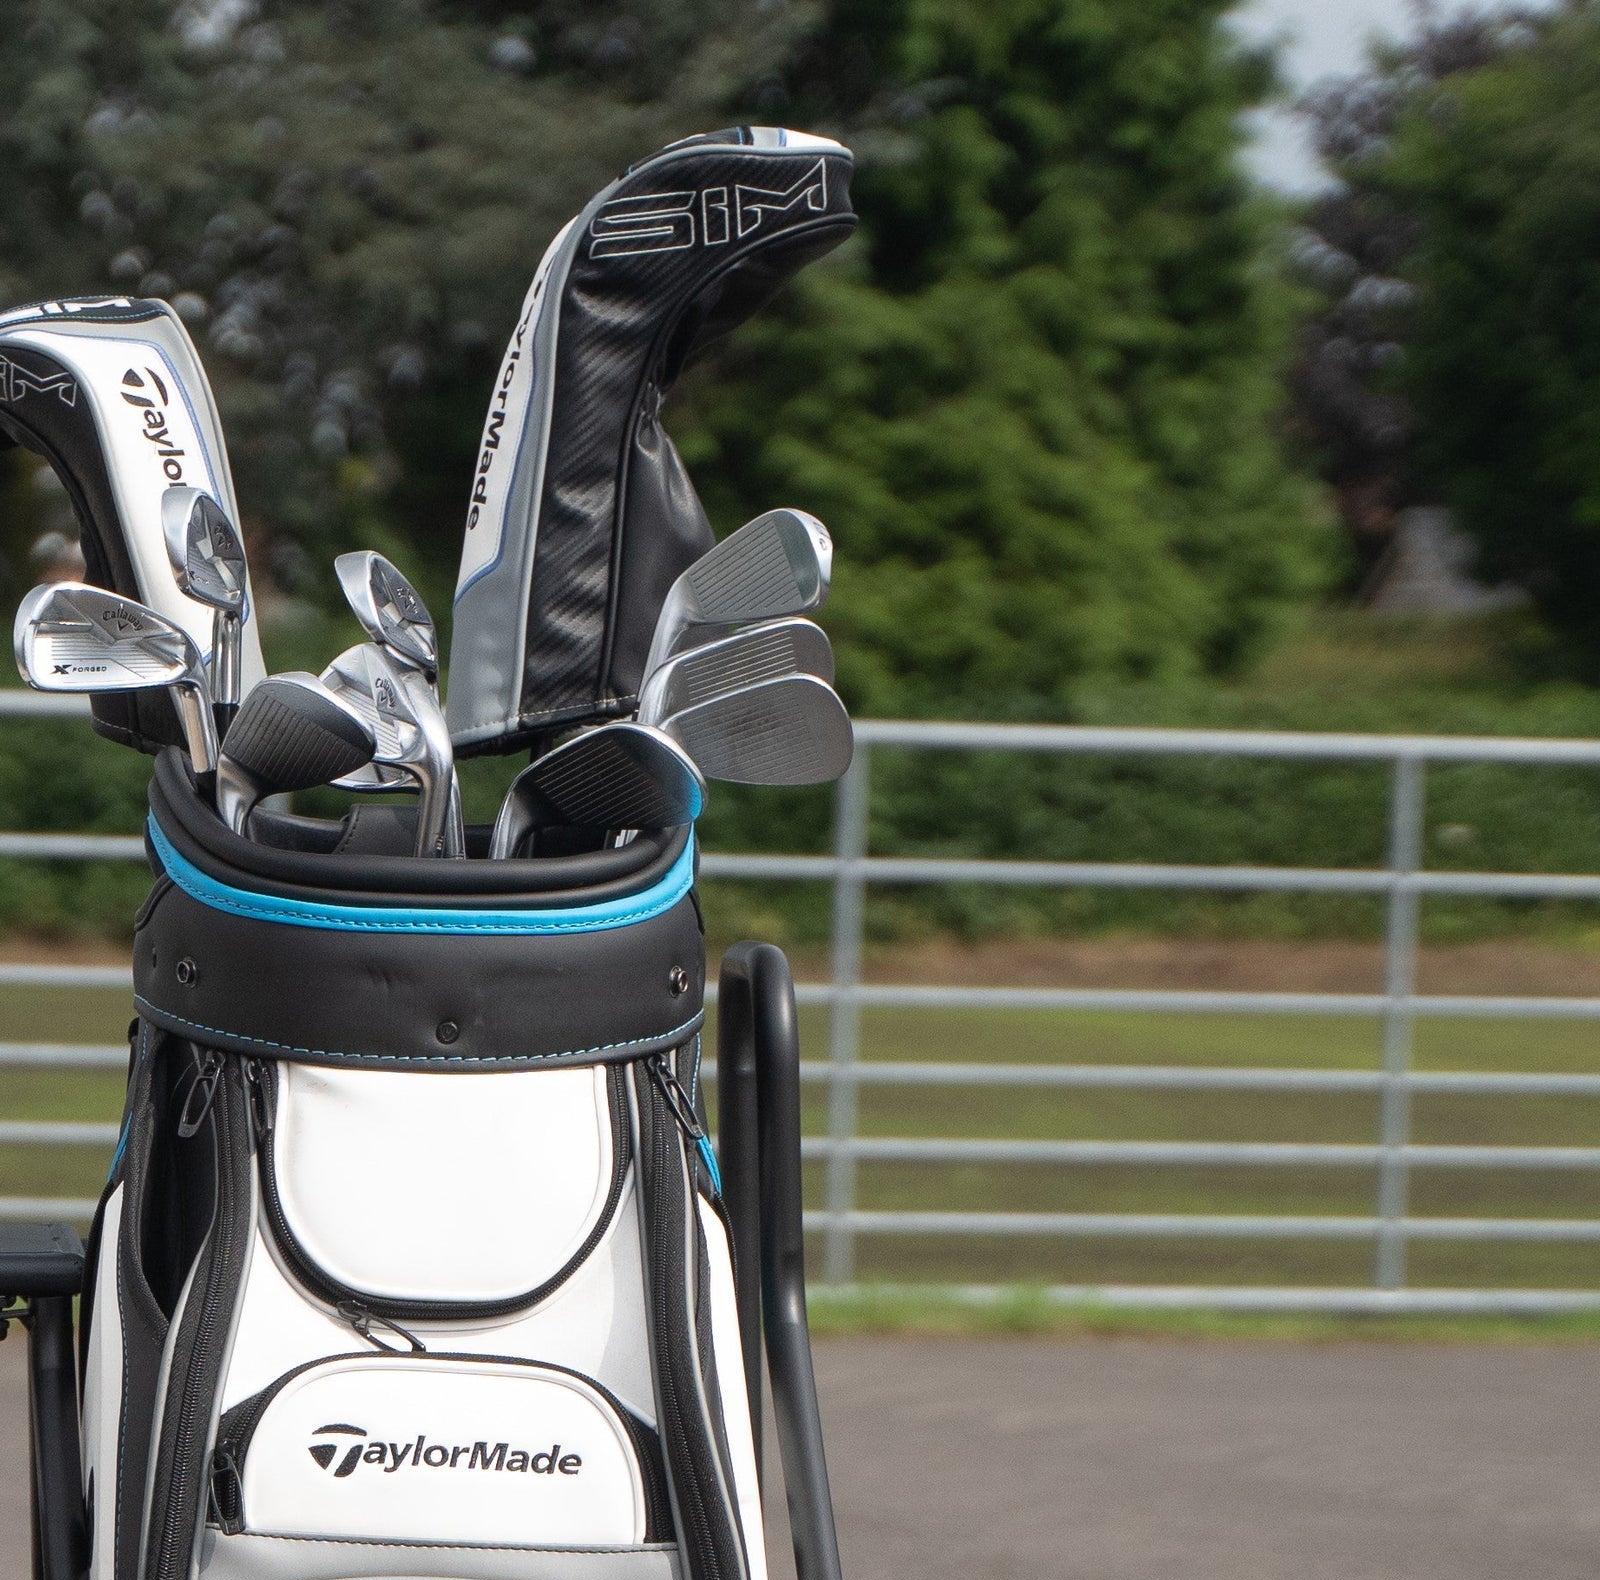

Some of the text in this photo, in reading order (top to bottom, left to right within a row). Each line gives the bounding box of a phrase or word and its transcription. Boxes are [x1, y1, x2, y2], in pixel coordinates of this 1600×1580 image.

[589, 157, 828, 260] SIM
[467, 254, 556, 530] ylorMade
[102, 604, 145, 632] Callaway
[308, 1422, 583, 1478] TaylorMade
